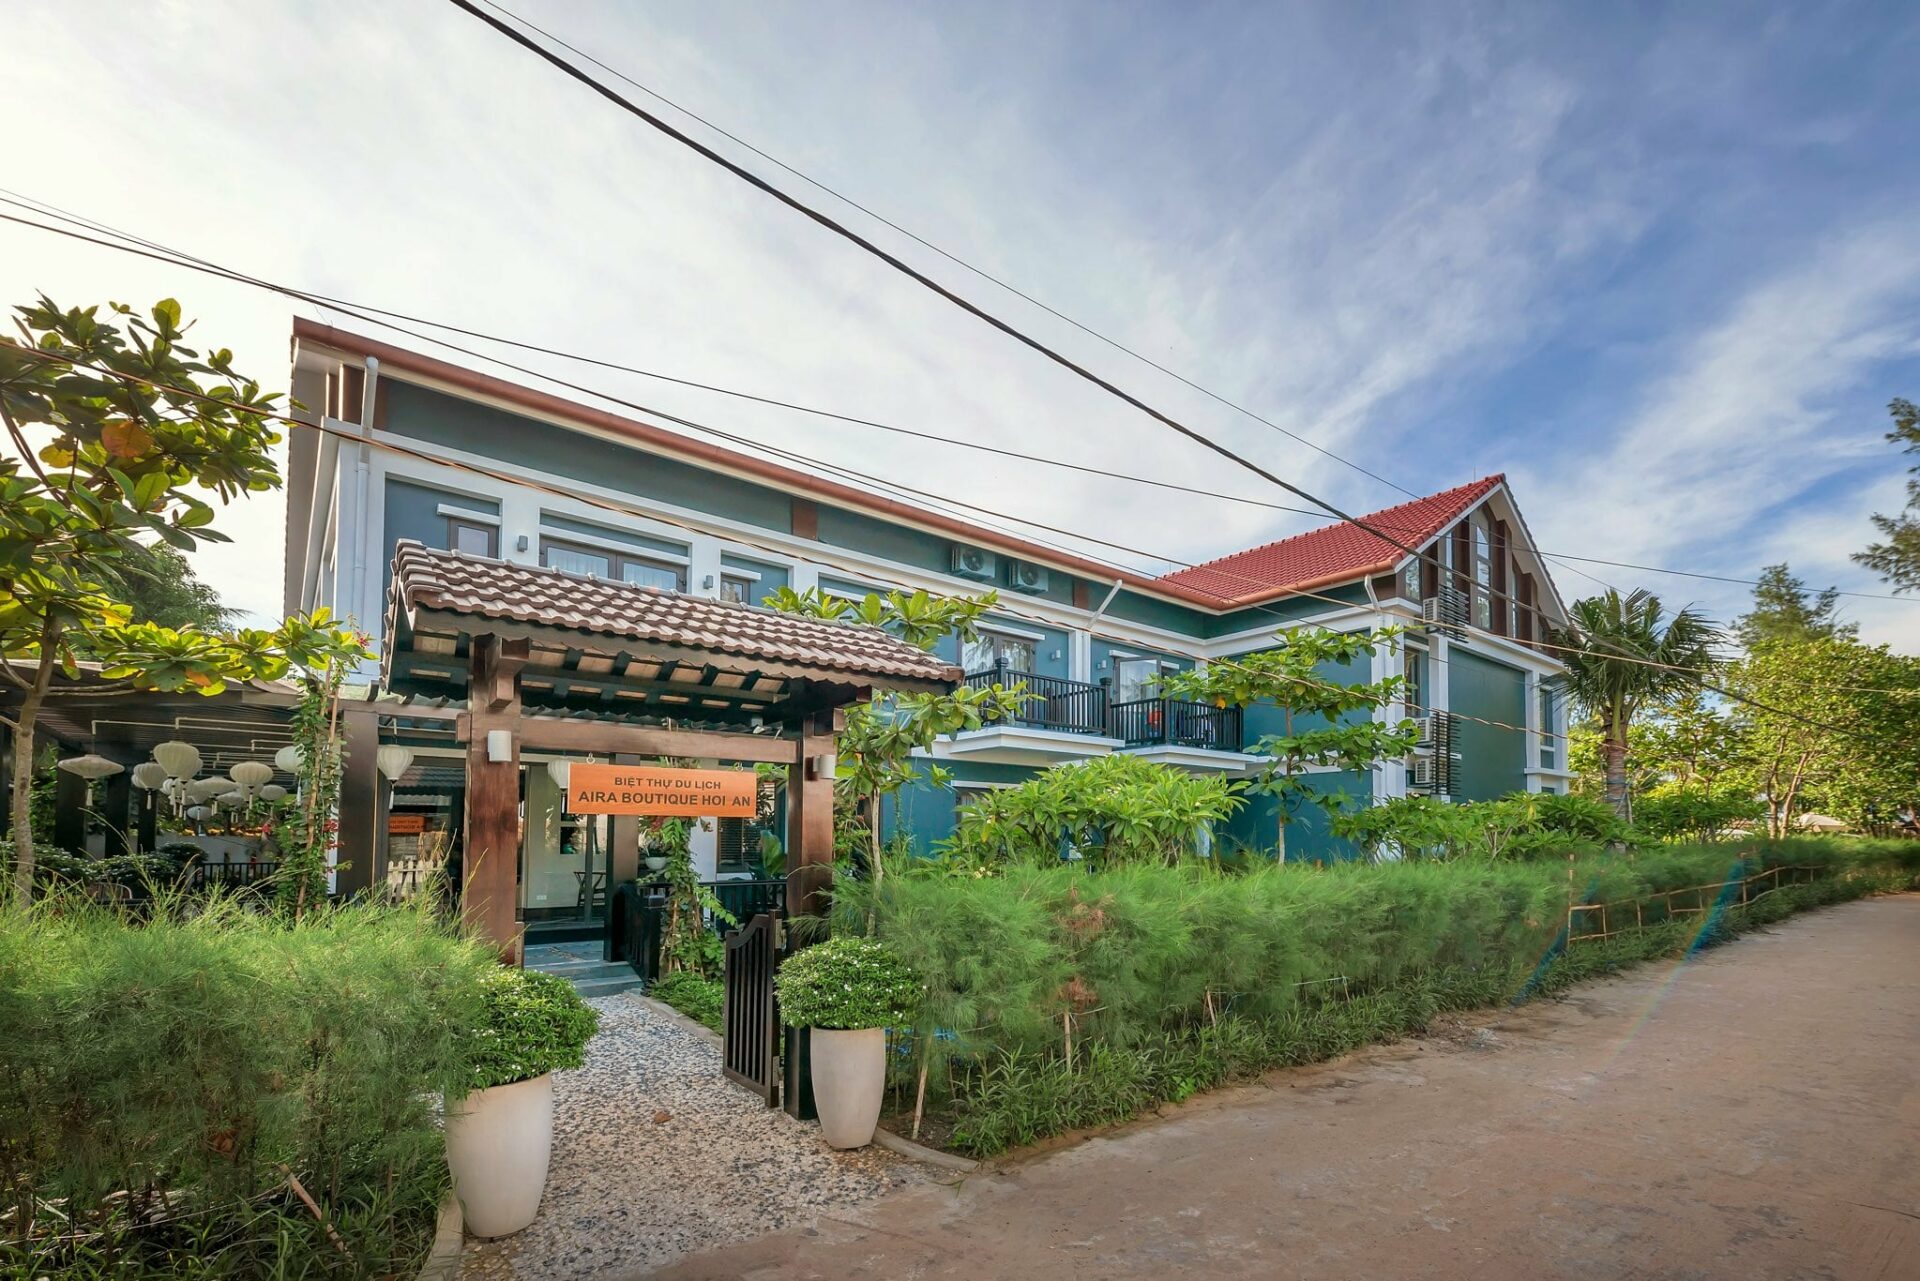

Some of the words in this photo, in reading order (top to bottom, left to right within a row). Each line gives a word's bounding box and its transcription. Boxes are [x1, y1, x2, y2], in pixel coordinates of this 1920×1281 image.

[614, 777, 644, 787] BIỆT
[675, 779, 691, 788] DU
[695, 780, 721, 791] LỊCH
[578, 791, 617, 803] AIRA
[621, 792, 698, 806] BOUTIQUE
[702, 795, 726, 806] HOI
[732, 796, 750, 807] AN
